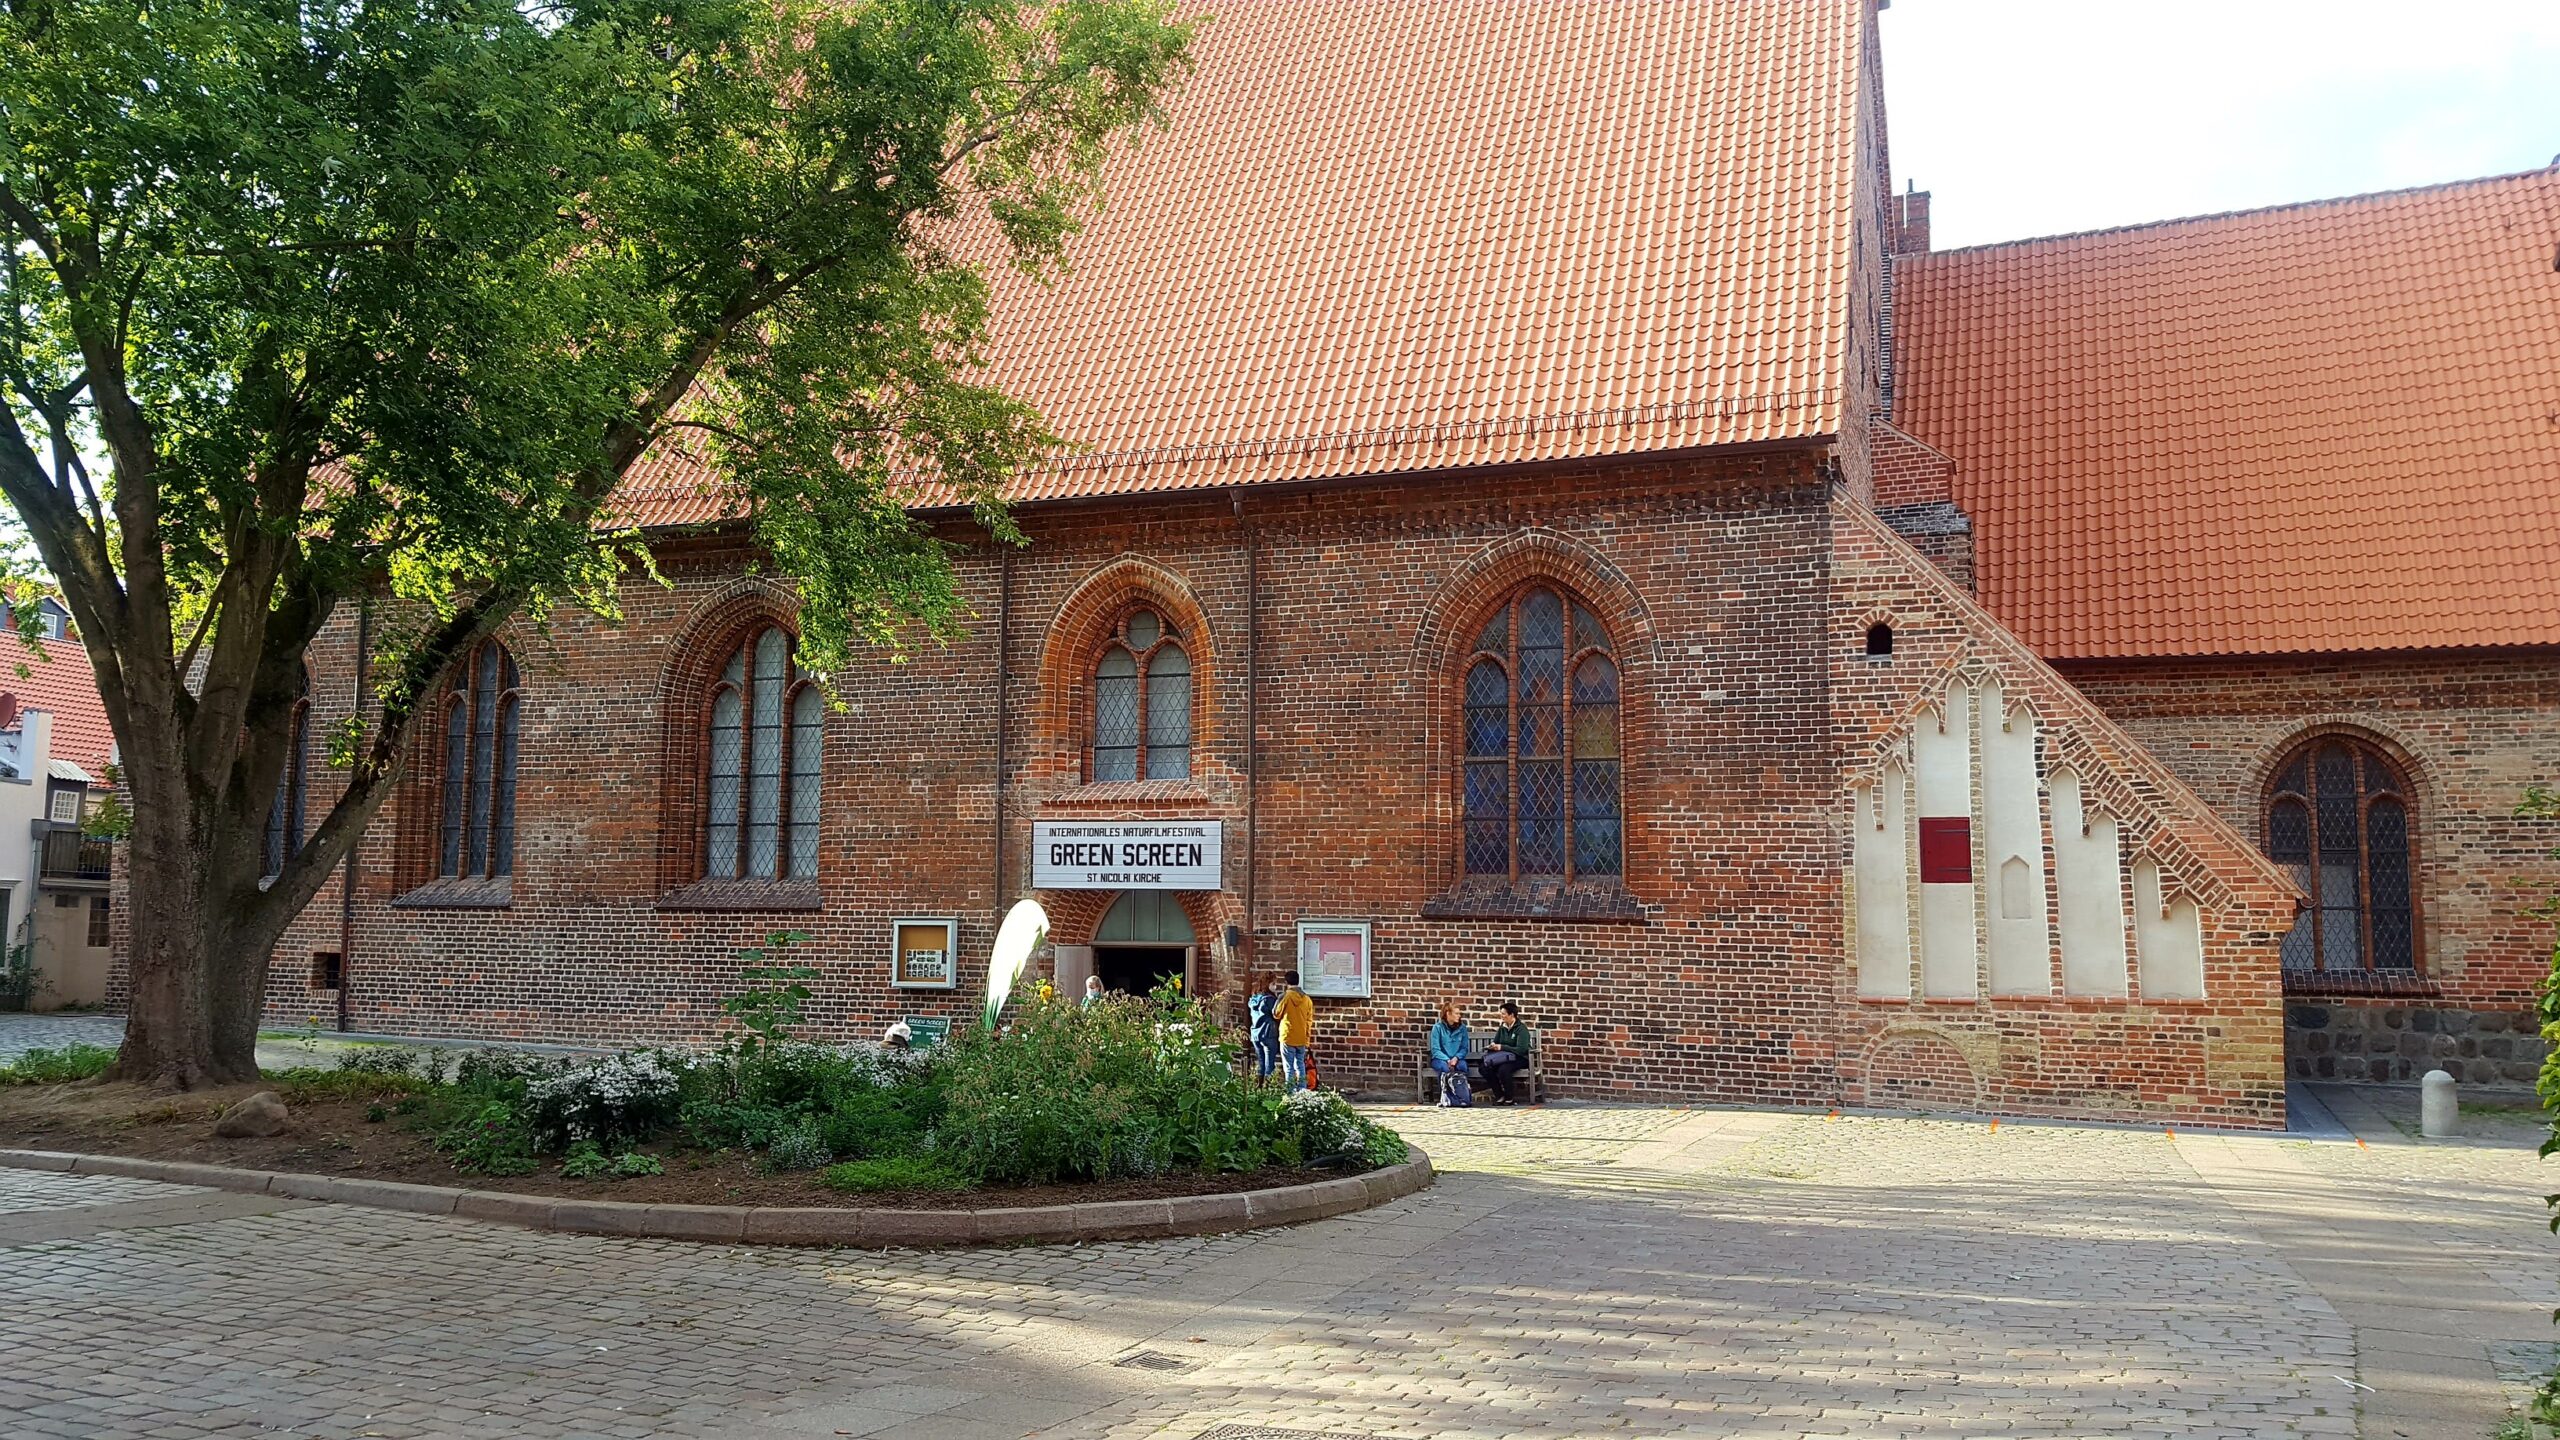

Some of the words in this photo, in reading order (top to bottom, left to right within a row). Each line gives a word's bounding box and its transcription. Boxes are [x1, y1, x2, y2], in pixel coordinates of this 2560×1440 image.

[1049, 827, 1120, 837] INTERNATIONALES
[1123, 827, 1206, 837] NATURFILMFESTIVAL
[1050, 843, 1114, 866] GREEN
[1122, 843, 1202, 867] SCREEN
[1087, 873, 1097, 883] ST
[1100, 873, 1130, 883] NICOLAI
[1133, 873, 1162, 883] KIRCHE
